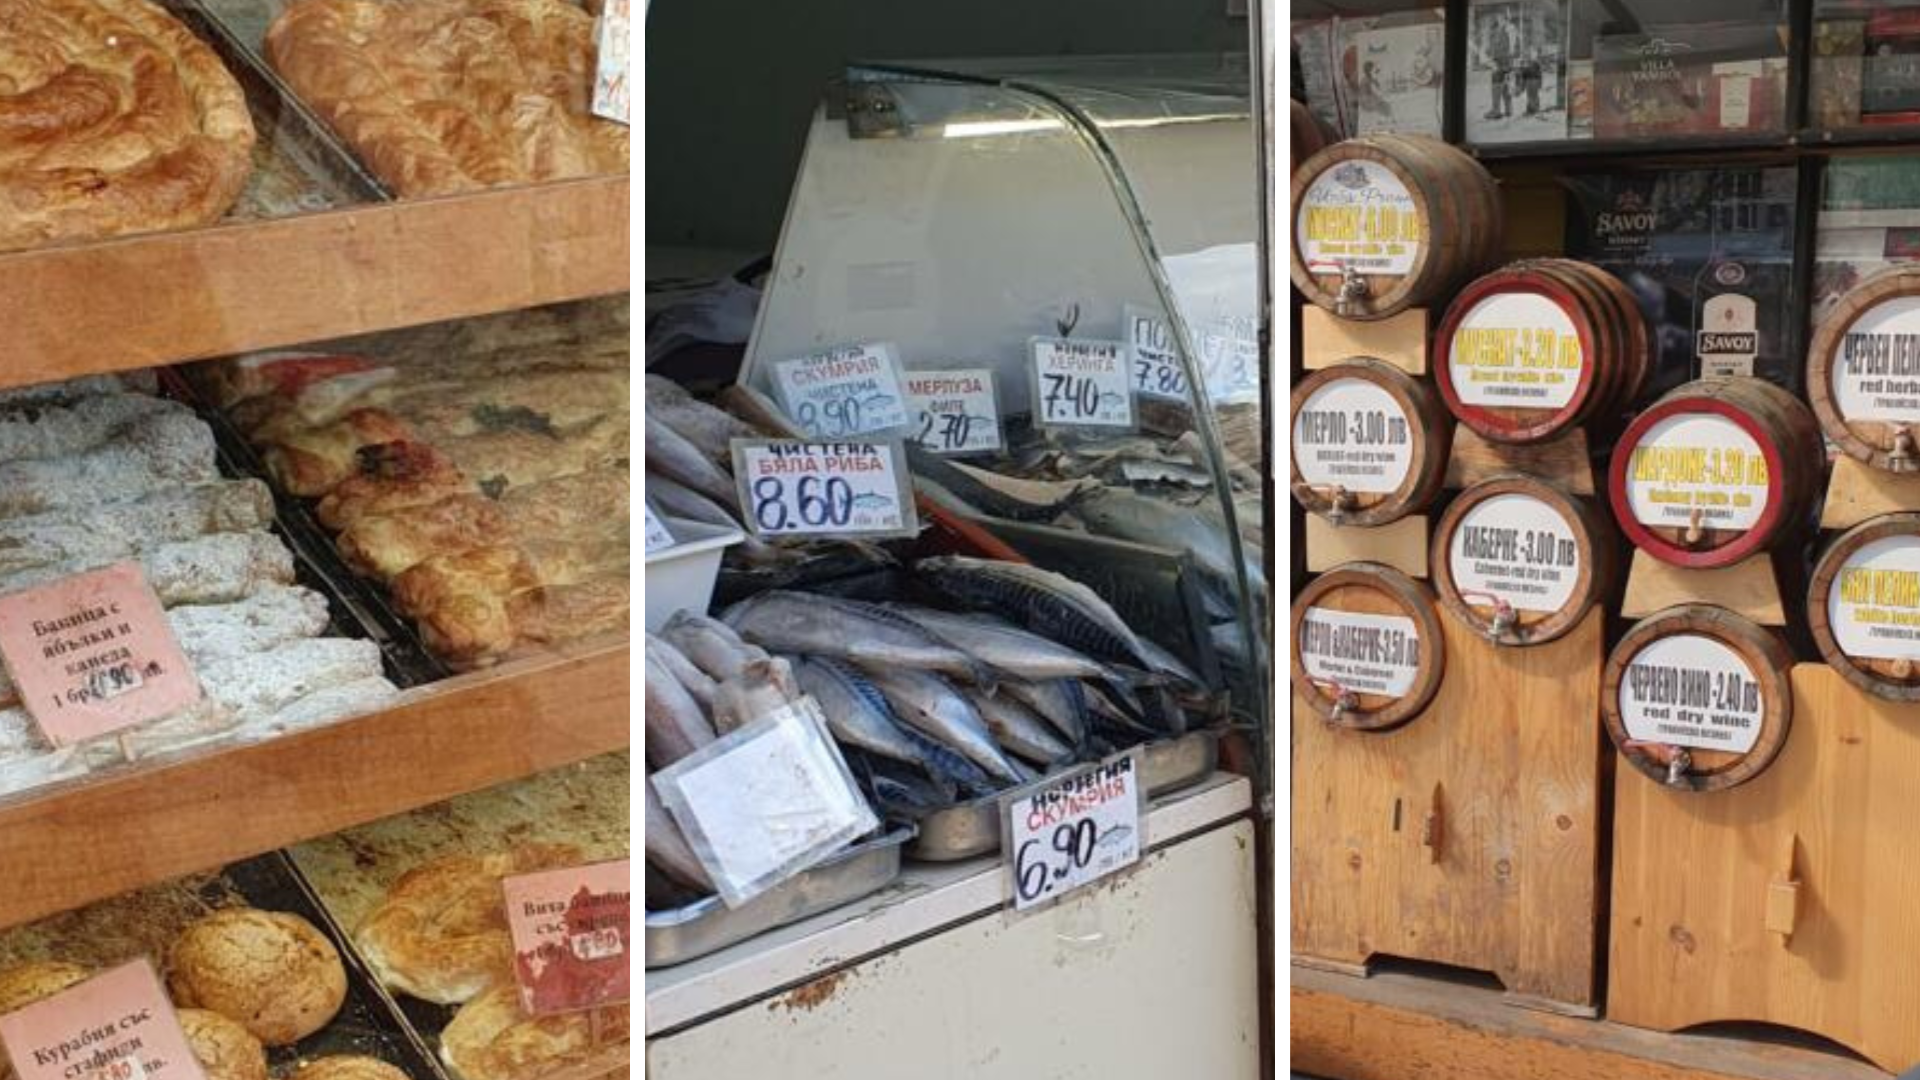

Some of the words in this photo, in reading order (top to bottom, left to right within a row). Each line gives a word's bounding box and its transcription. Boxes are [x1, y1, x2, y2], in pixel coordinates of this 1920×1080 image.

[1596, 212, 1657, 236] SAVOY
[1702, 333, 1754, 352] SAVOY
[792, 356, 880, 385] СКУМРИЯ
[907, 377, 983, 396] МЕРЛУЗА
[1859, 379, 1883, 394] red
[1042, 372, 1099, 418] 7.40
[1302, 410, 1346, 445] МЕРЛО
[758, 458, 818, 475] БЯЛА
[825, 456, 884, 473] РИБА
[753, 475, 853, 530] 8.60
[1463, 525, 1519, 562] КАБЕРНЕ
[42, 626, 115, 660] ябълки
[117, 622, 132, 636] и
[1630, 664, 1678, 706] ЧЕРВЕНО
[1679, 667, 1711, 709] ВИНО
[1643, 707, 1670, 719] red
[1677, 709, 1704, 725] dry
[1711, 714, 1751, 729] wine
[1026, 778, 1127, 832] СКУМРИЯ
[1016, 817, 1097, 901] 6.90
[523, 900, 567, 917] Вита
[32, 1020, 118, 1067] Курабия
[119, 1008, 152, 1030] със
